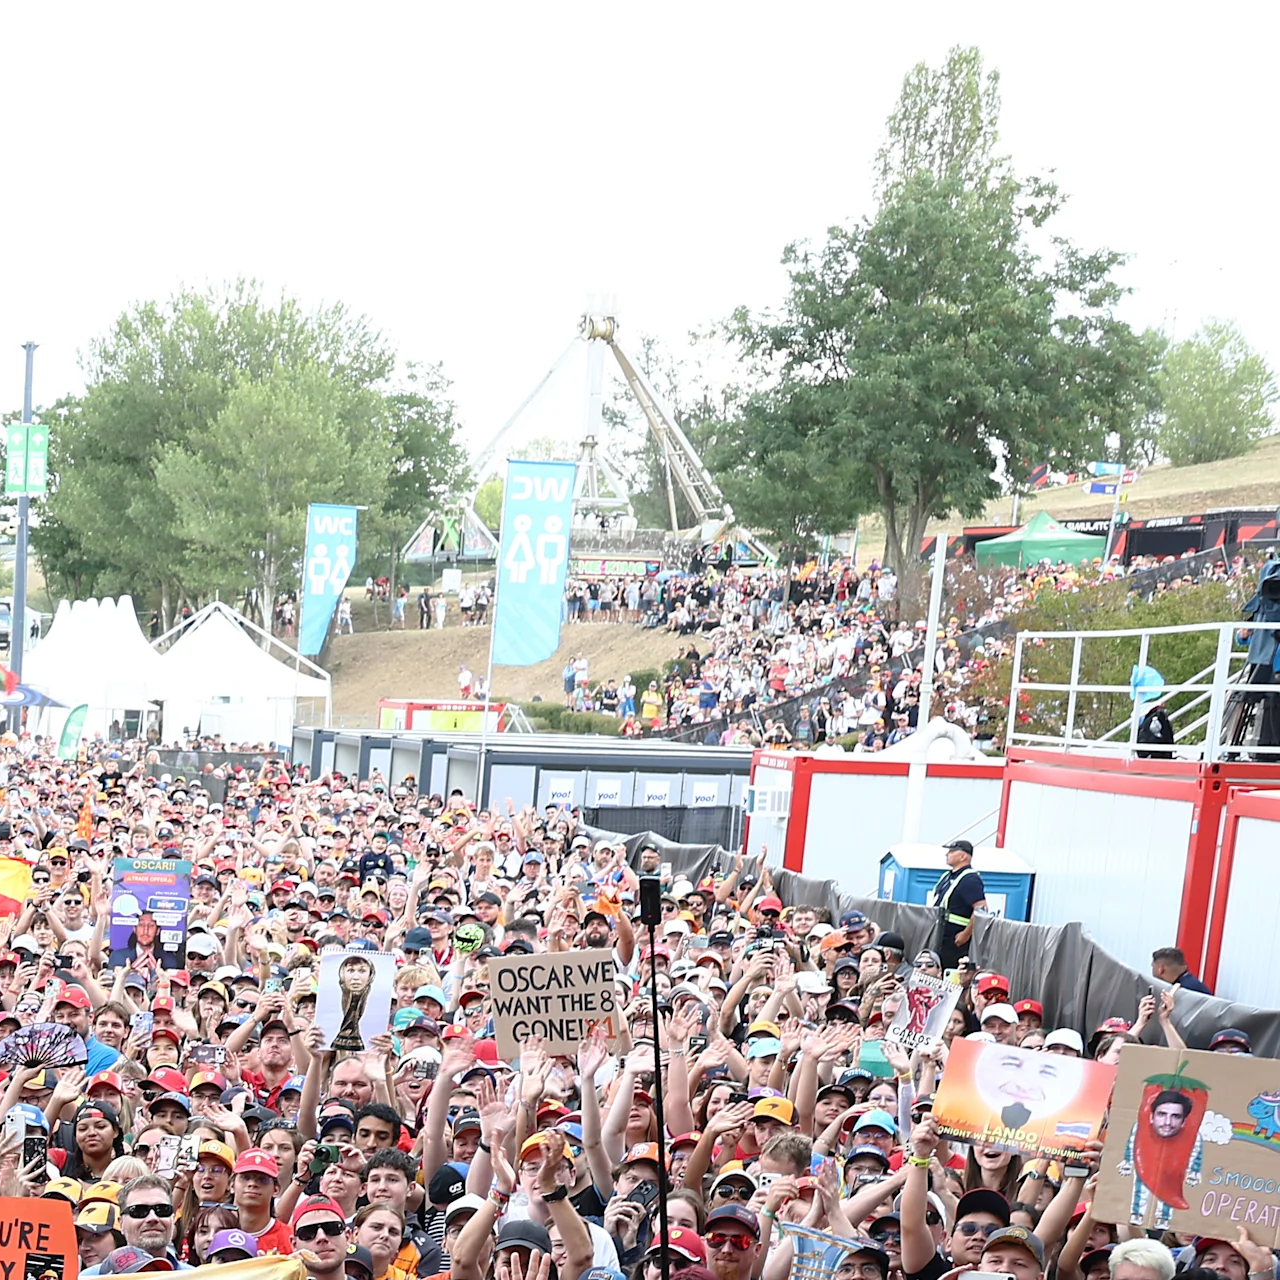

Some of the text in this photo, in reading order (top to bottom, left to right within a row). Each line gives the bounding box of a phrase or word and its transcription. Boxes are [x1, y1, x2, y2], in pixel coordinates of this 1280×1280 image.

[314, 516, 354, 536] WC
[605, 561, 646, 575] KING
[551, 790, 571, 799] yoo!
[598, 792, 618, 800] yoo!
[647, 793, 667, 801] yoo!
[695, 794, 715, 803] yoo!
[133, 860, 176, 870] OSCAR!!
[498, 961, 614, 992] OSCAR WE
[493, 990, 614, 1017] WANT THE 8
[892, 1026, 931, 1046] CARLOS
[973, 1132, 1038, 1150] WE STEAL THE
[983, 1124, 1038, 1143] LANDO
